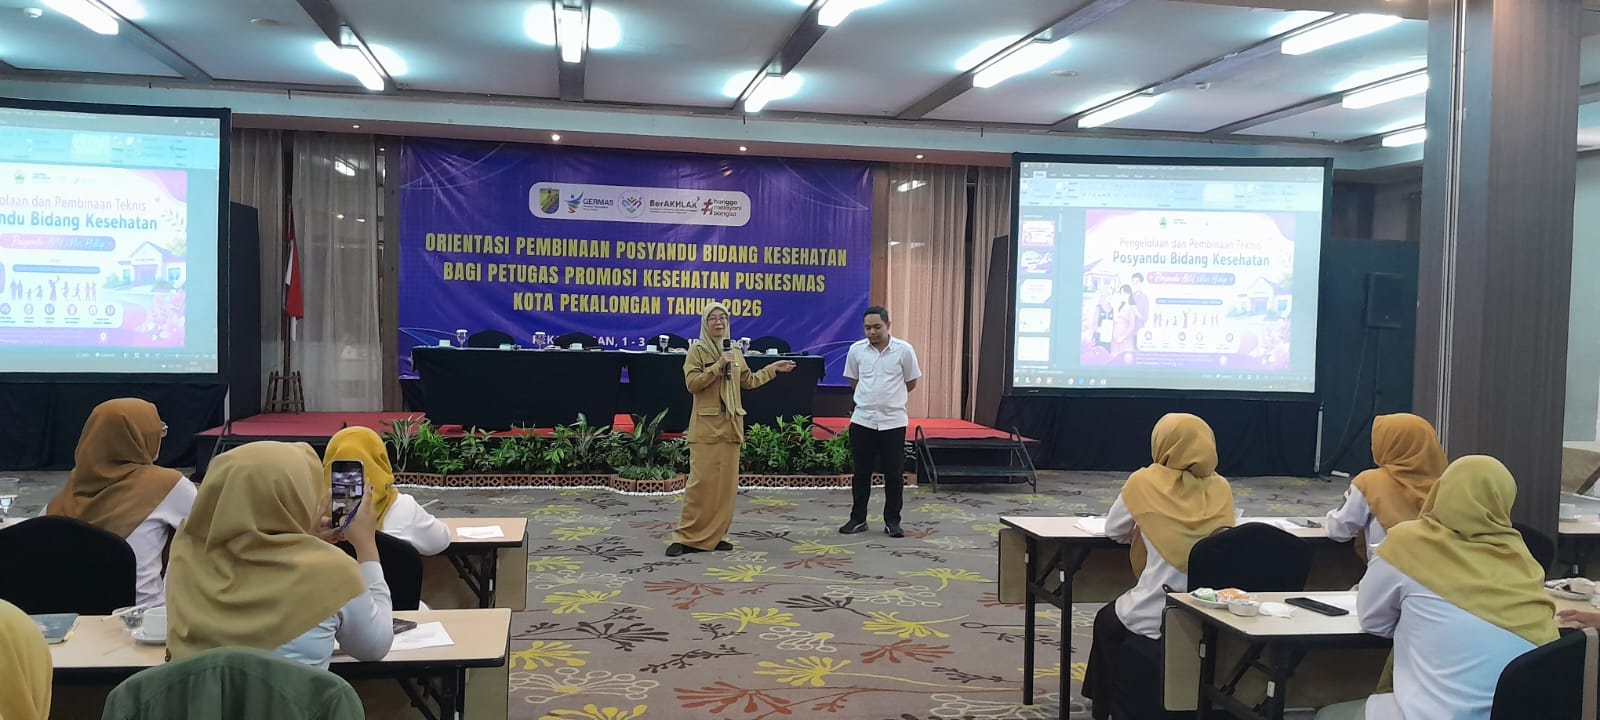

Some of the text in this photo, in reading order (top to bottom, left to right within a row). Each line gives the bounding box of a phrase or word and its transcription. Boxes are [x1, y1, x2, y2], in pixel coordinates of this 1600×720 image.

[32, 195, 51, 207] dan
[55, 196, 112, 209] Pembinaan
[115, 198, 146, 211] Teknis
[583, 198, 614, 206] GERMAS
[649, 198, 698, 208] BerAKHLAK
[31, 211, 80, 231] Bidang
[86, 213, 157, 230] Kesehatan
[425, 233, 847, 266] ORIENTASI PEMBINAAN POSYANDU BIDANG KESEHATAN
[1172, 238, 1187, 248] dan
[1113, 251, 1270, 268] Posyandu Bidang Kesehatan
[443, 262, 825, 292] BAGI PETUGAS PROMOSI KESEHATAN PUSKESMAS
[513, 292, 554, 312] KOTA
[560, 294, 660, 315] PEKALONGAN
[622, 336, 628, 346] 1
[638, 337, 646, 346] 3
